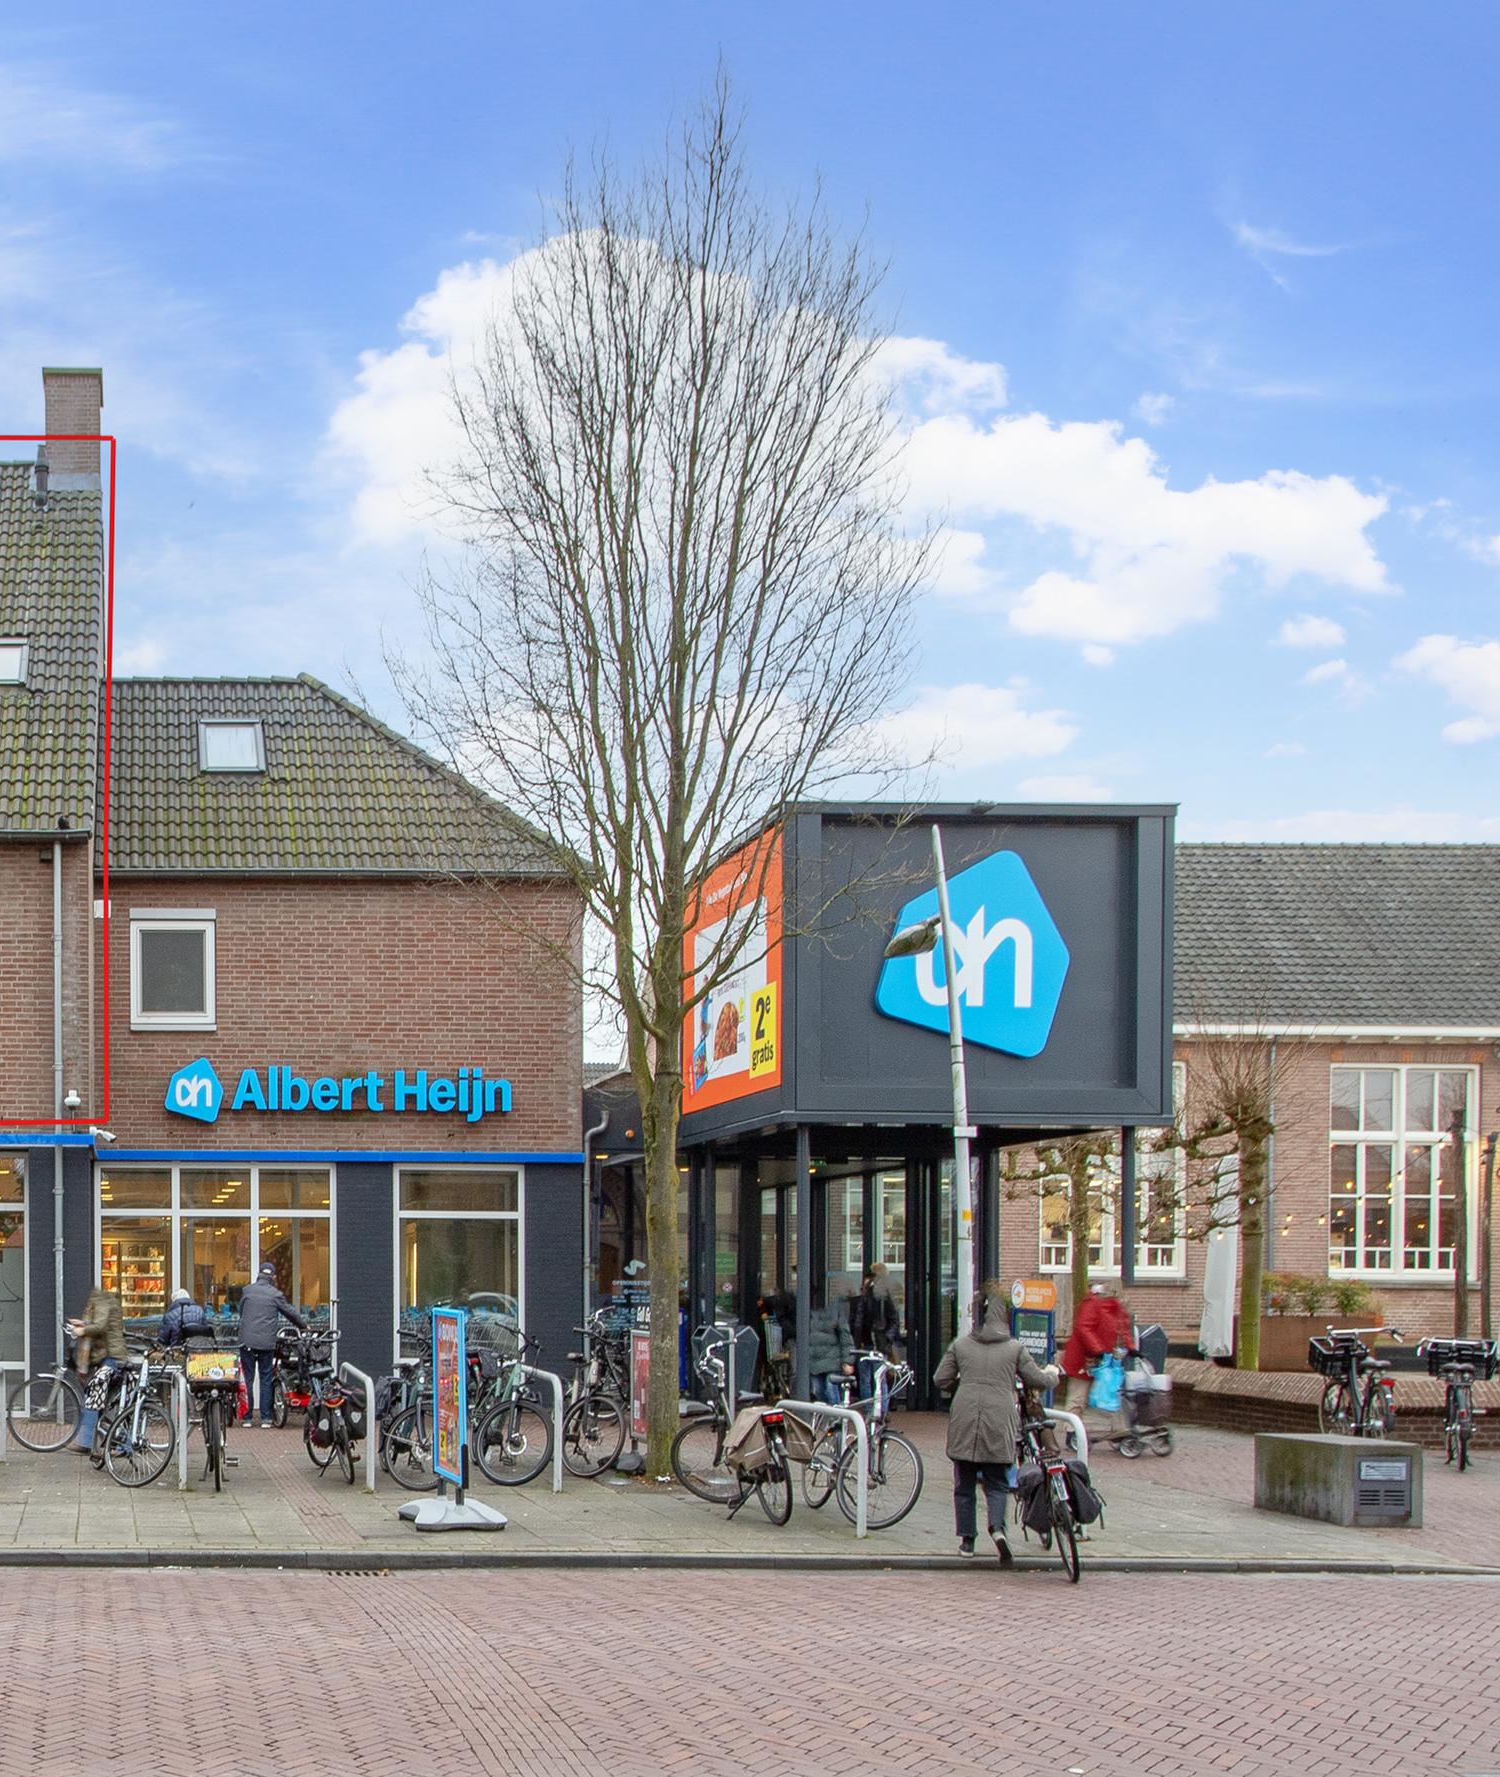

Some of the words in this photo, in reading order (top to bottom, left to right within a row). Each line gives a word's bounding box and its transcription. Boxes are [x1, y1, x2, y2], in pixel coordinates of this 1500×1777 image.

[752, 1040, 774, 1071] gratis
[231, 1065, 384, 1112] Albert
[394, 1066, 513, 1122] Heijn
